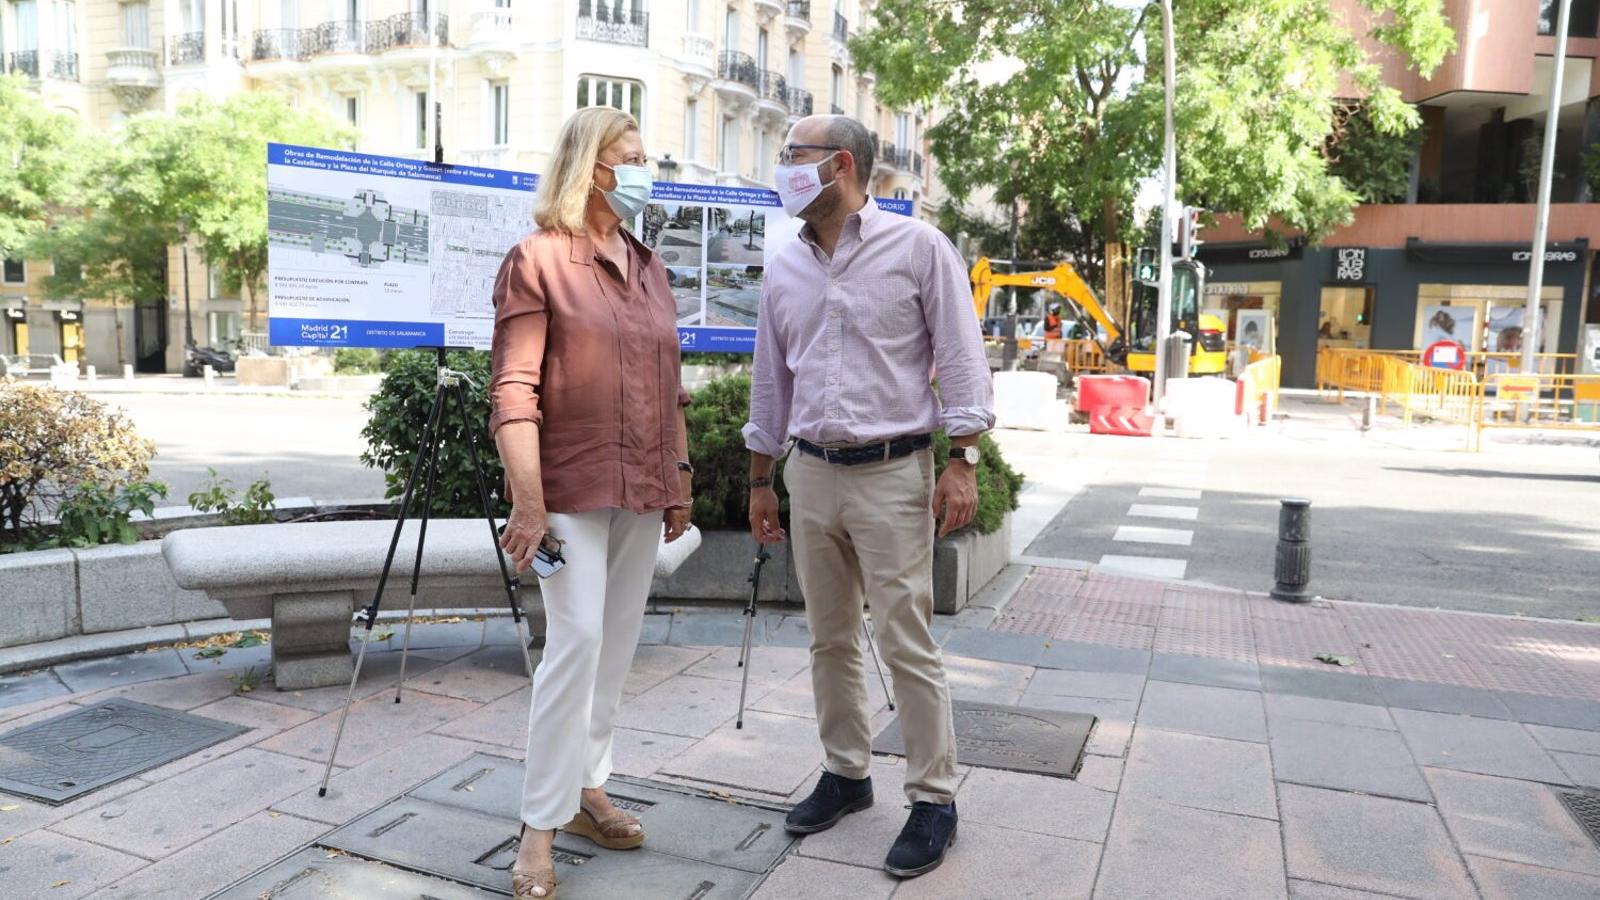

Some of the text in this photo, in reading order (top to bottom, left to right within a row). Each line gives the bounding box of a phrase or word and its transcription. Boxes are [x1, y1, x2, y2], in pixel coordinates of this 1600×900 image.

[284, 149, 304, 157] Obras
[316, 152, 362, 164] Remodelación
[379, 160, 394, 168] Calle
[396, 162, 417, 171] Ortega
[292, 158, 326, 168] Castellana
[340, 163, 357, 171] Plaza
[1031, 276, 1057, 285] JCB
[301, 324, 329, 332] Madrid
[330, 325, 348, 340] 21
[681, 332, 696, 345] 21
